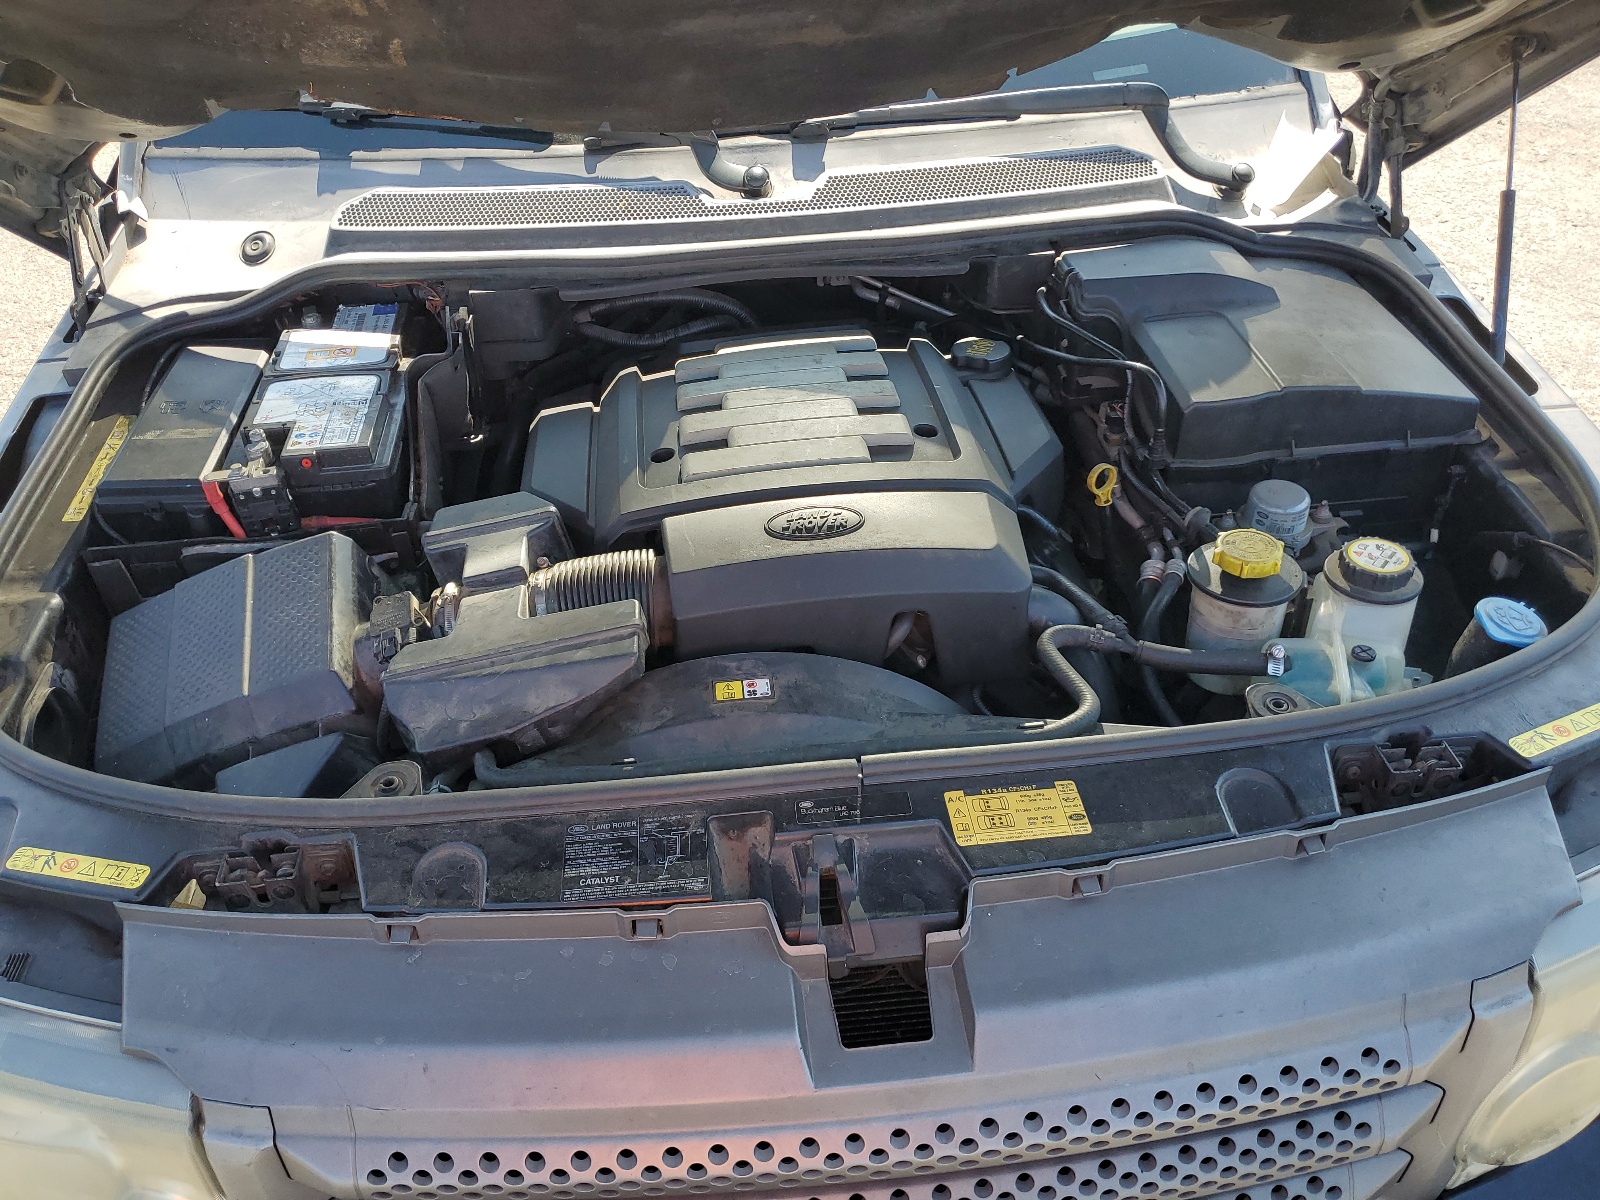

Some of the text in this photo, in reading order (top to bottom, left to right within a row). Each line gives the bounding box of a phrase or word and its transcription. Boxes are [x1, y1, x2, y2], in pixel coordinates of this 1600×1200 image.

[791, 517, 849, 535] ROVER
[800, 806, 834, 815] Buckingham
[591, 822, 611, 831] LAND
[612, 820, 637, 829] ROVER
[579, 875, 621, 886] CATALYST
